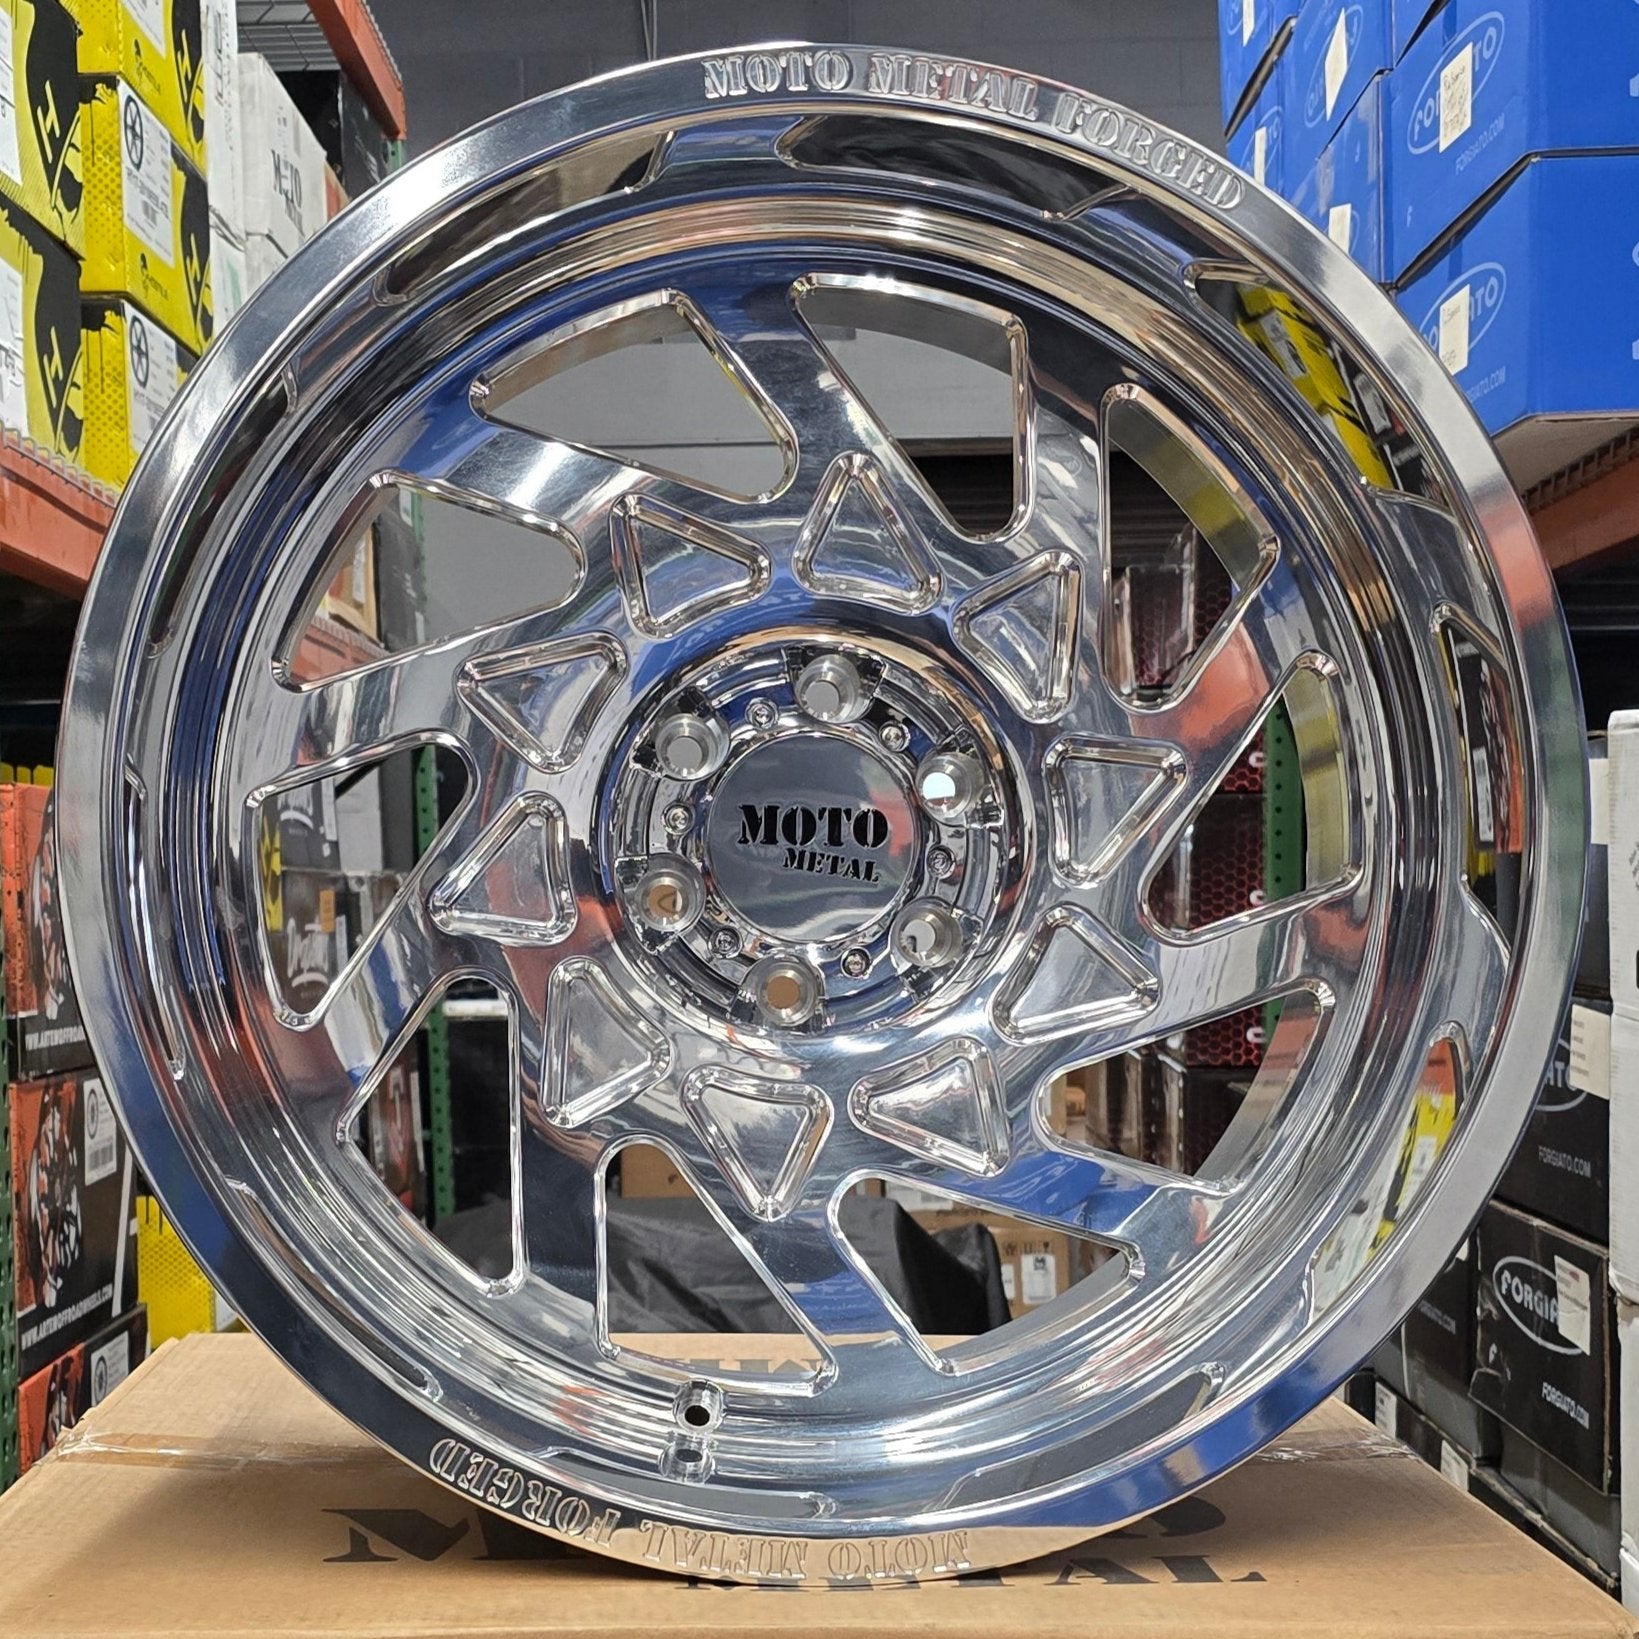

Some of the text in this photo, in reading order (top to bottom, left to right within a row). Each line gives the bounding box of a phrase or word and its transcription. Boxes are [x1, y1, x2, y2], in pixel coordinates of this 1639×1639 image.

[702, 50, 1246, 210] MOTO METAL FORGED
[737, 804, 888, 848] MOTO
[782, 848, 879, 882] METAL
[1500, 1269, 1559, 1324] FORGIA
[428, 1437, 622, 1548] FORGED
[639, 1518, 809, 1580] METAL
[826, 1530, 971, 1581] MOTO
